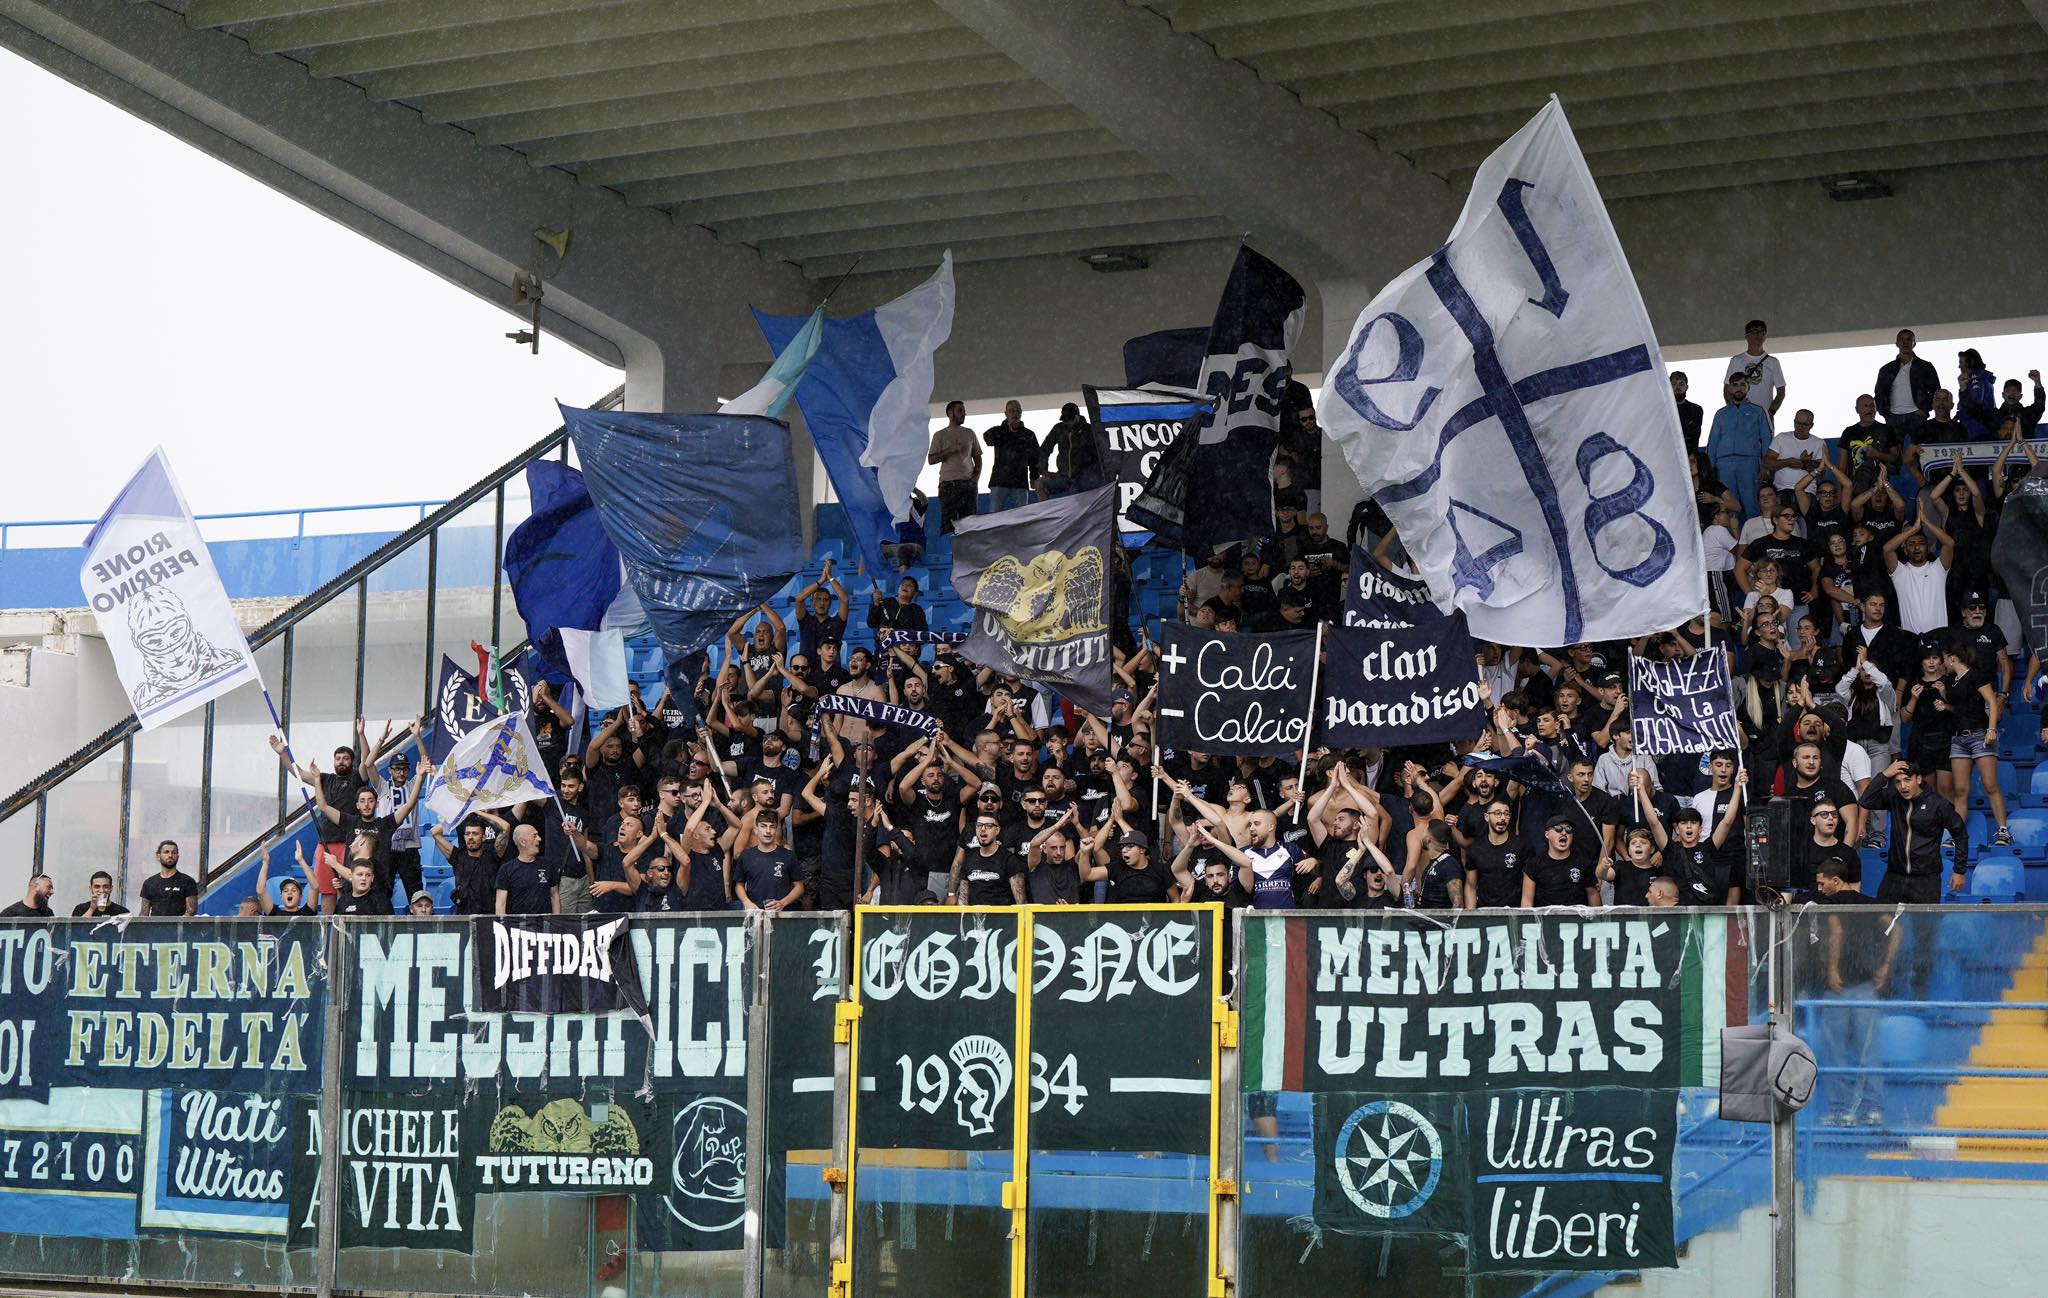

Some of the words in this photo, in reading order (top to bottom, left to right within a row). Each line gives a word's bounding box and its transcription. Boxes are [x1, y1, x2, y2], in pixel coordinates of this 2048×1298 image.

[1362, 640, 1437, 682] clan
[1195, 691, 1308, 743] Calcio
[1326, 681, 1480, 730] paradiso
[69, 941, 310, 999] ETERNA
[808, 920, 1200, 1002] LEGIONE
[1315, 1000, 1663, 1078] ULTRAS
[180, 1091, 287, 1143] Nati
[1486, 1096, 1657, 1169] Ultras
[4, 1141, 134, 1183] 72100
[475, 1155, 653, 1185] TUTURANO
[1489, 1187, 1641, 1259] liberi
